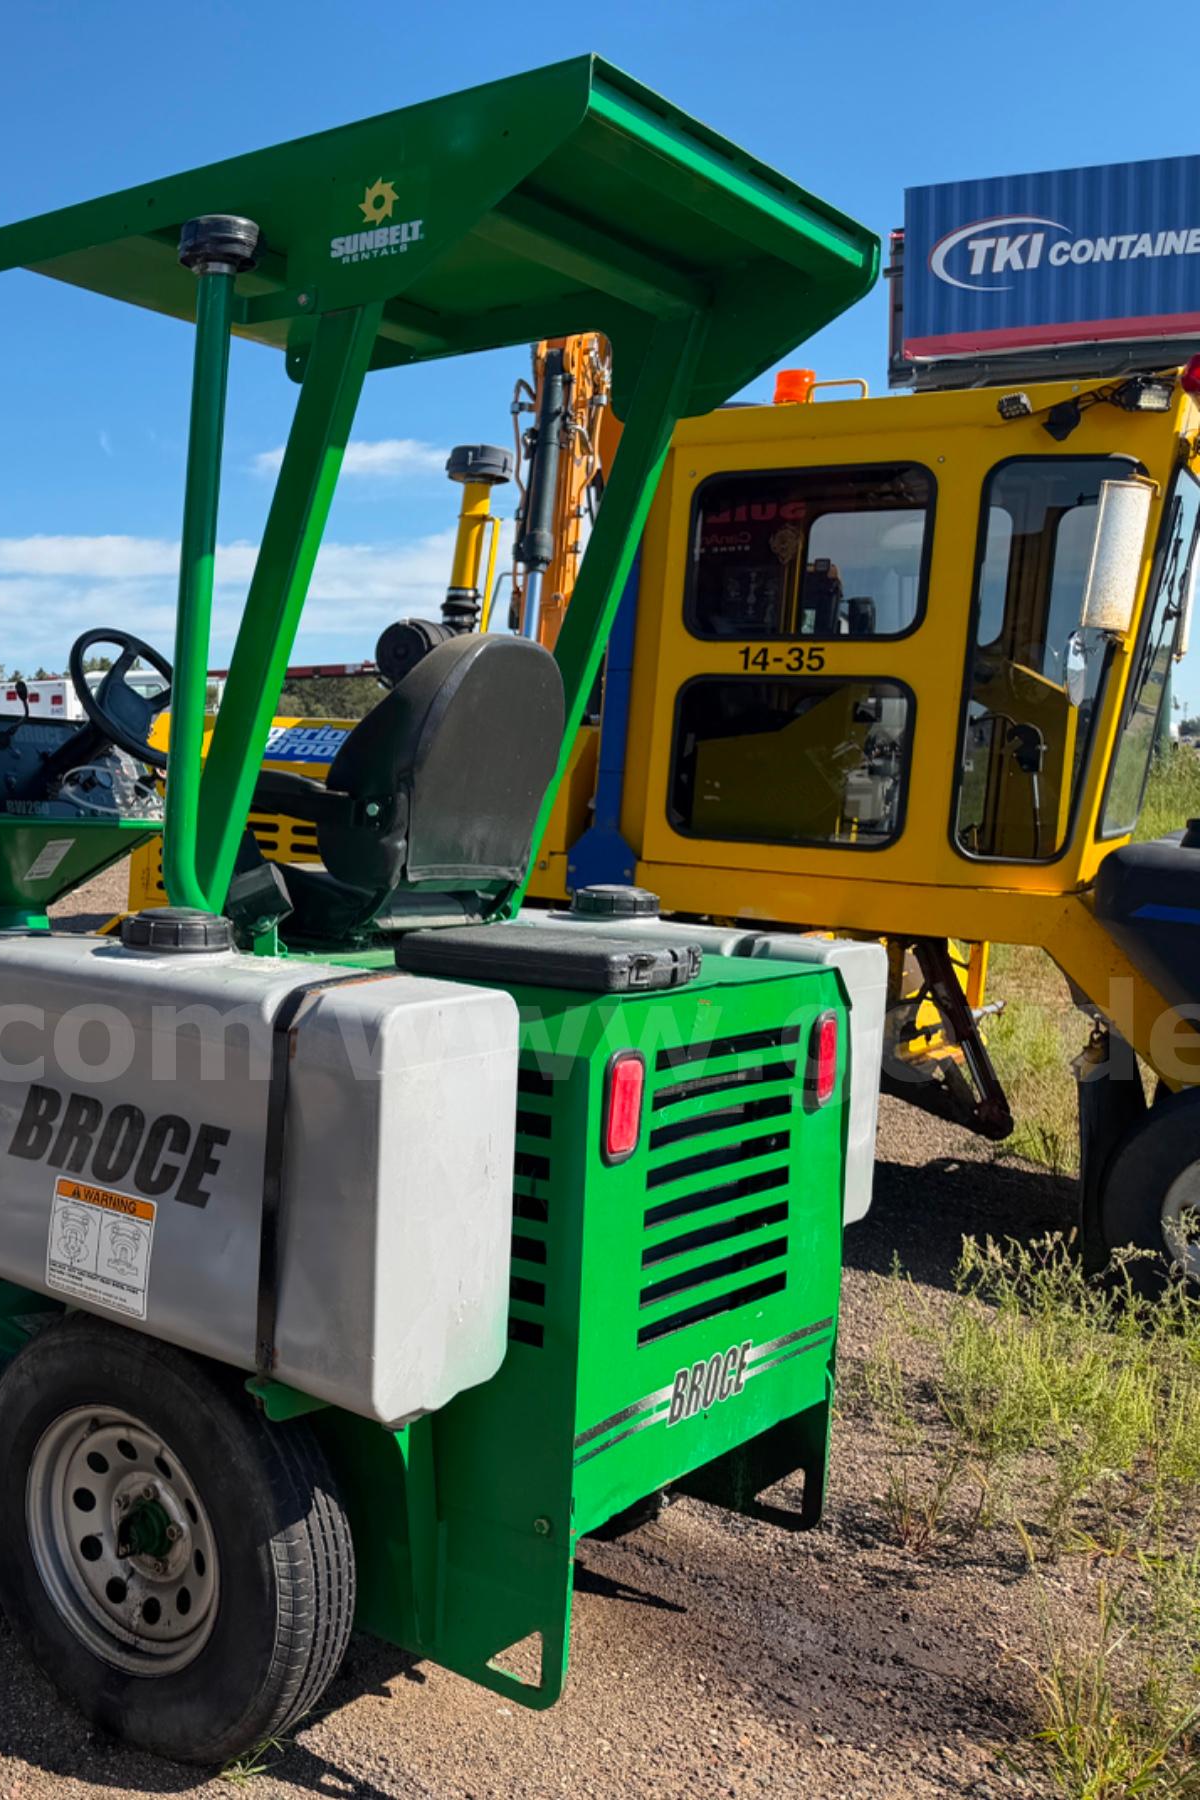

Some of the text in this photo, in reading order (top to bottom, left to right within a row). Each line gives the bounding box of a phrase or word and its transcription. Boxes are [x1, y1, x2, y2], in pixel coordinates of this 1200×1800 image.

[330, 219, 422, 258] SUNBELT
[341, 243, 408, 264] RENTALS
[968, 228, 1200, 276] TKI CONTAINE
[738, 646, 825, 672] 14-35
[8, 1083, 231, 1209] BROCE
[83, 1188, 138, 1214] WARNING
[666, 1339, 753, 1428] BROCE
